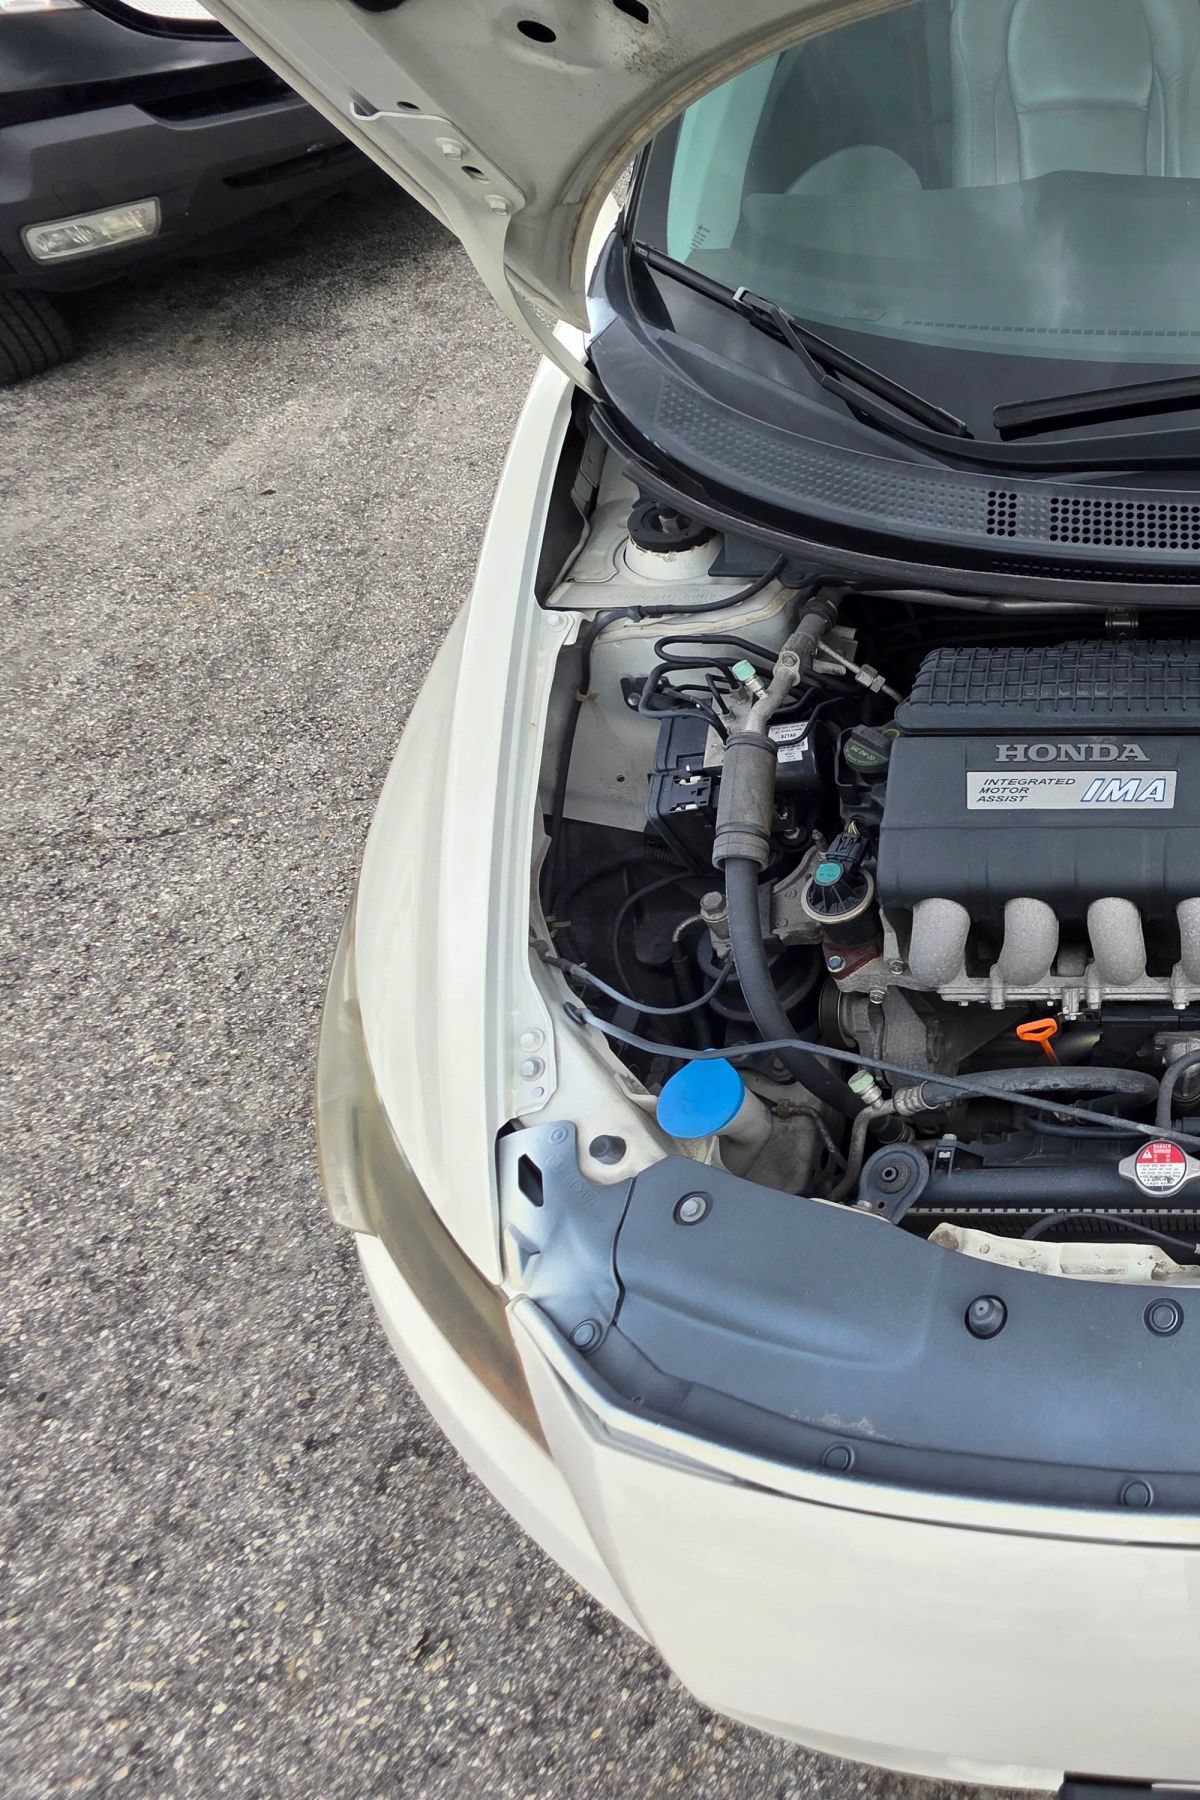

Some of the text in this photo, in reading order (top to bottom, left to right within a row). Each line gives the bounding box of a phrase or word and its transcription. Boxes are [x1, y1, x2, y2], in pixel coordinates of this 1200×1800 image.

[995, 743, 1151, 762] HONDA
[983, 778, 1076, 786] INTEGRATED
[1080, 777, 1167, 802] IMA
[976, 795, 1028, 803] ASSIST
